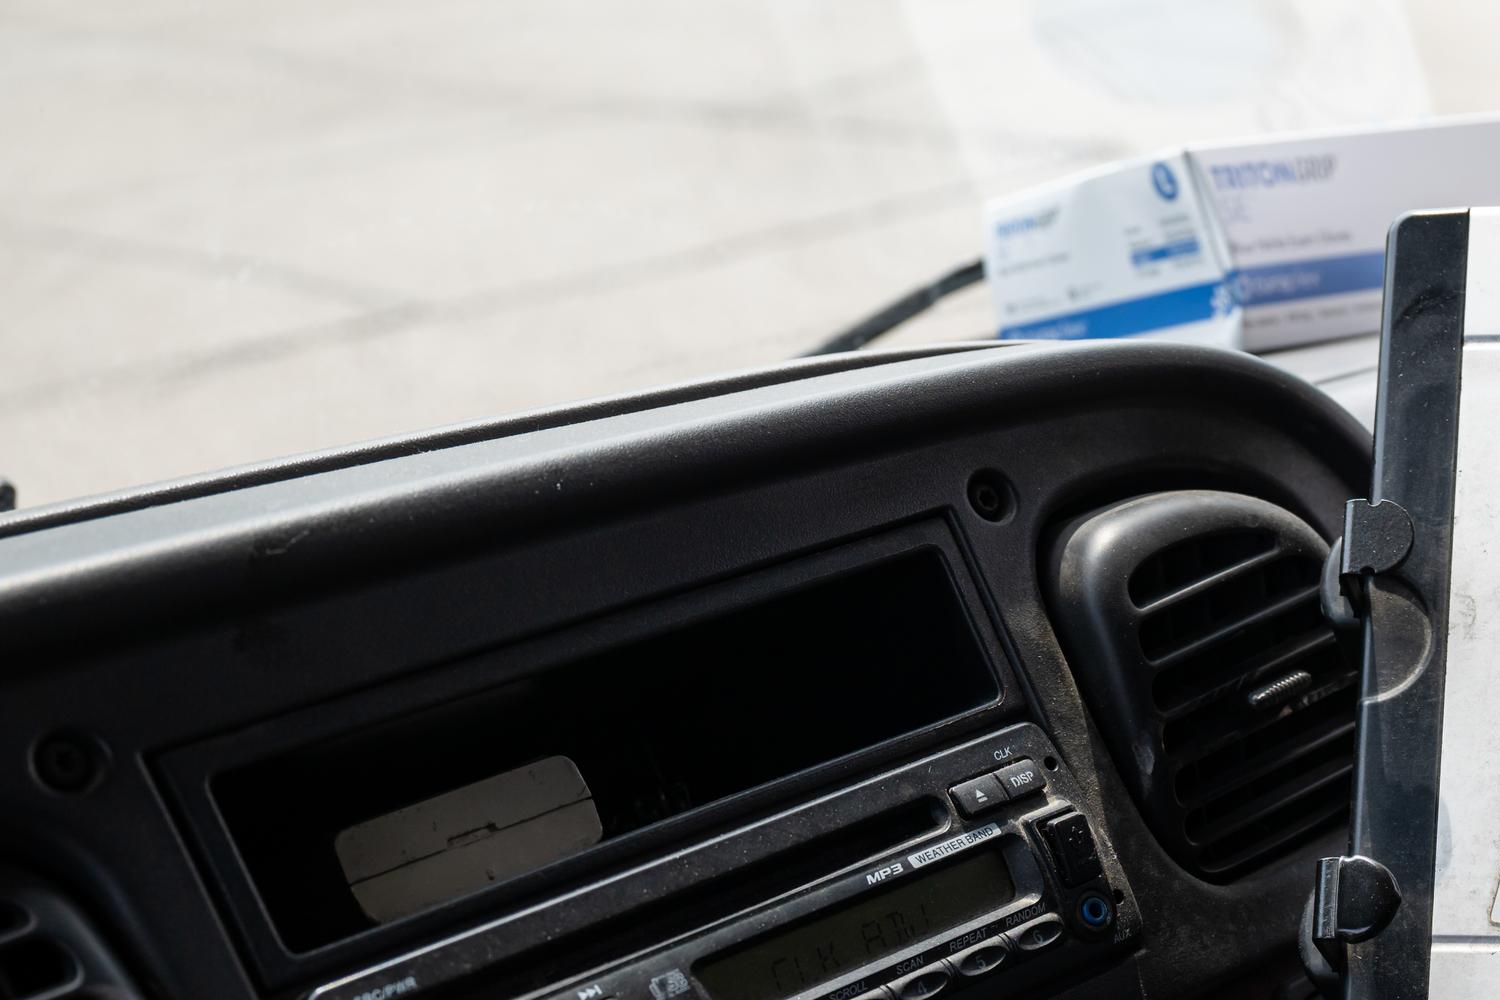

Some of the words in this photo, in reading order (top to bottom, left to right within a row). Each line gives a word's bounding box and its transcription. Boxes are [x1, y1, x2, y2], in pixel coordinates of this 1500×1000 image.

[993, 747, 1013, 761] CLK
[1010, 770, 1034, 788] DISP
[866, 864, 904, 886] MP3
[915, 838, 967, 864] WEATHER
[967, 826, 994, 846] BAND
[1006, 902, 1046, 926] RANDOM
[950, 928, 988, 951] REPEAT
[1033, 929, 1044, 945] 6
[896, 955, 925, 976] SCAN
